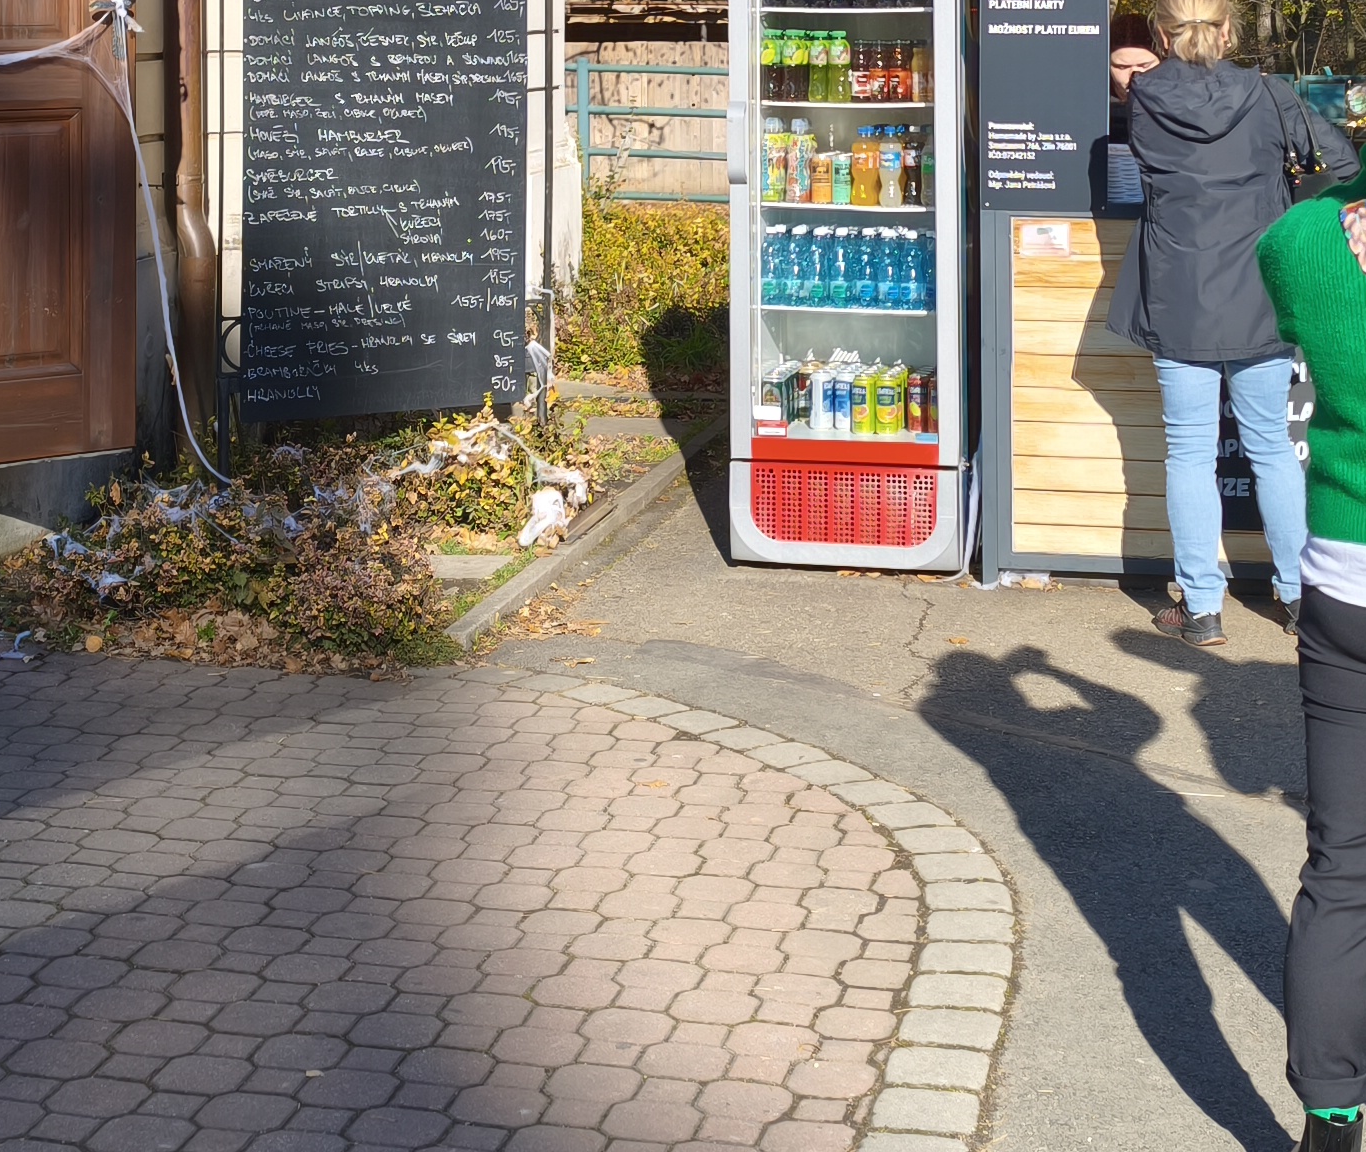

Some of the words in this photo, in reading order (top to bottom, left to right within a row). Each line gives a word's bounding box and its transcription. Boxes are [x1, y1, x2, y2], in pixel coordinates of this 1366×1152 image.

[1034, 0, 1065, 9] KARTY
[988, 22, 1033, 34] MOŽNOST
[1034, 25, 1067, 34] PLATIT
[1068, 25, 1100, 34] EUREM
[249, 29, 295, 46] DOMÁCÍ
[246, 50, 292, 66] DOMÁCÍ
[370, 56, 381, 66] S
[446, 55, 454, 65] A
[247, 67, 290, 83] DOMÁCÍ
[351, 71, 361, 82] S
[335, 92, 345, 104] S
[415, 92, 454, 106] MASEM
[317, 128, 410, 144] HAMBURGER
[398, 202, 408, 213] S
[380, 275, 439, 293] HRANOLKY
[247, 306, 312, 320] POUTINE
[247, 340, 297, 358] CHEESE
[306, 340, 349, 355] FRIES
[420, 334, 437, 345] SE
